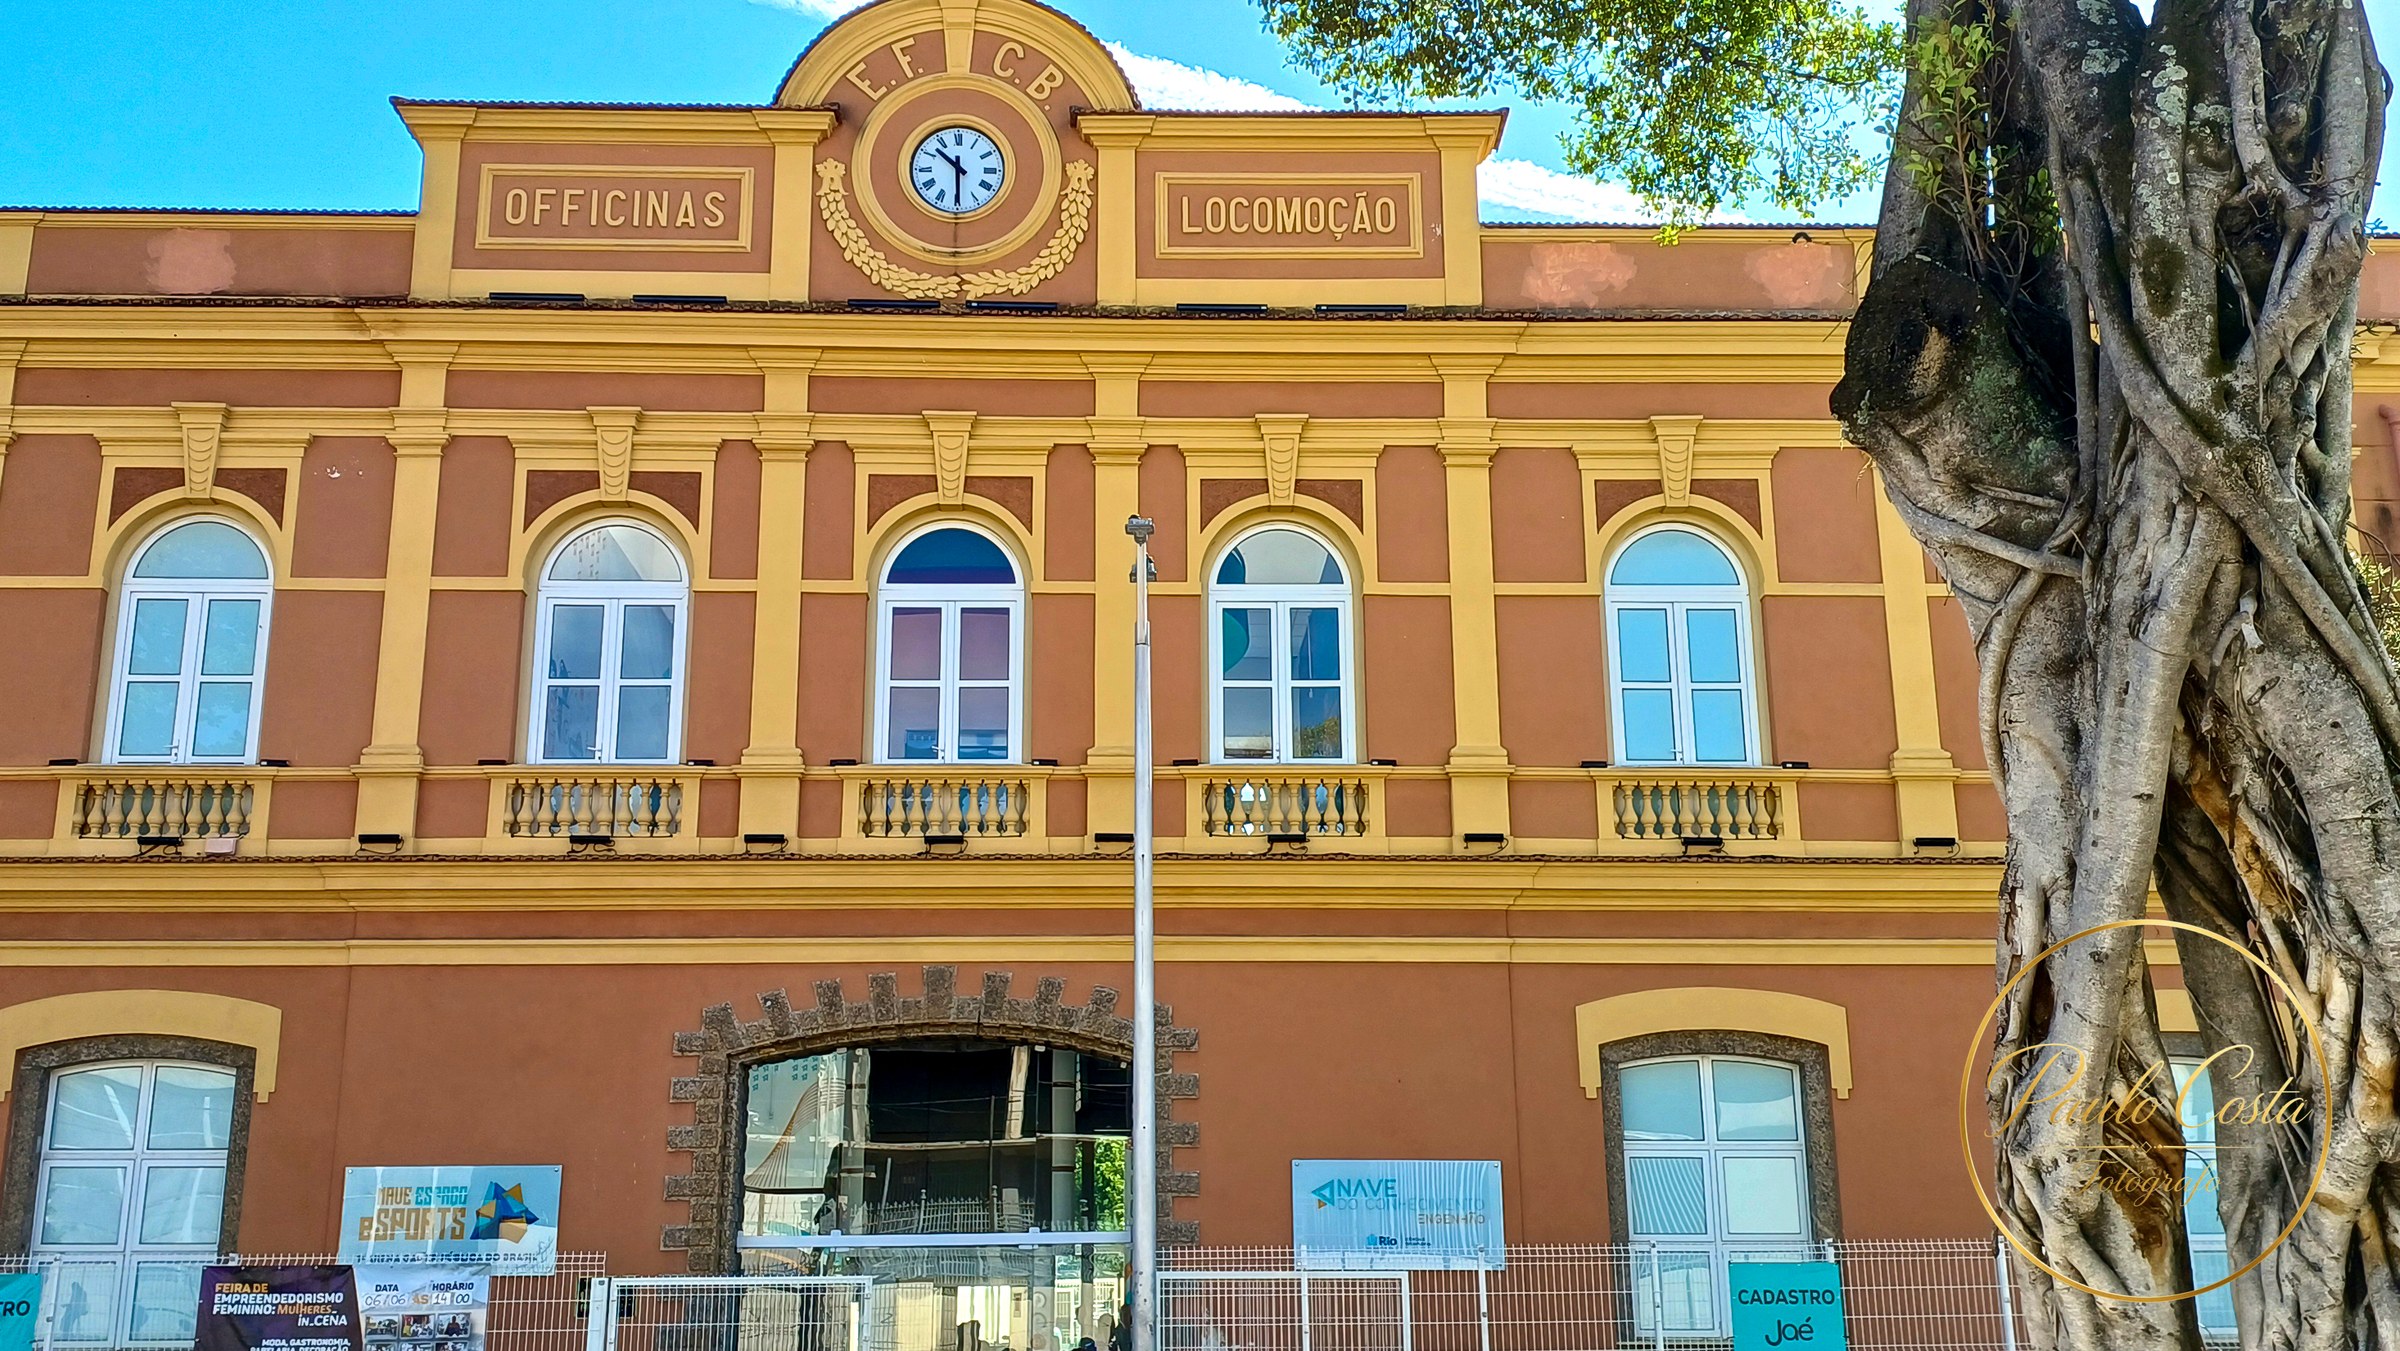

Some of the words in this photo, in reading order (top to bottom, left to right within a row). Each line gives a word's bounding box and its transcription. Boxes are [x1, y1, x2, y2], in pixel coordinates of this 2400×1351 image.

[504, 187, 727, 229] OFFICINAS
[1180, 190, 1397, 242] LOCOMOÇÃO
[1337, 1178, 1398, 1198] NAVE
[1337, 1198, 1359, 1211] DO
[1379, 1235, 1398, 1246] Rio
[485, 1252, 501, 1262] DO
[214, 1283, 251, 1293] FEIRA
[252, 1283, 269, 1293] DE
[375, 1284, 399, 1292] DATA
[432, 1280, 475, 1292] HORÁRIO
[213, 1292, 344, 1304] EMPREENDEDORISMO
[1737, 1289, 1835, 1305] CADASTRO
[212, 1304, 277, 1315] FEMININO:
[1764, 1316, 1814, 1347] Jaé
